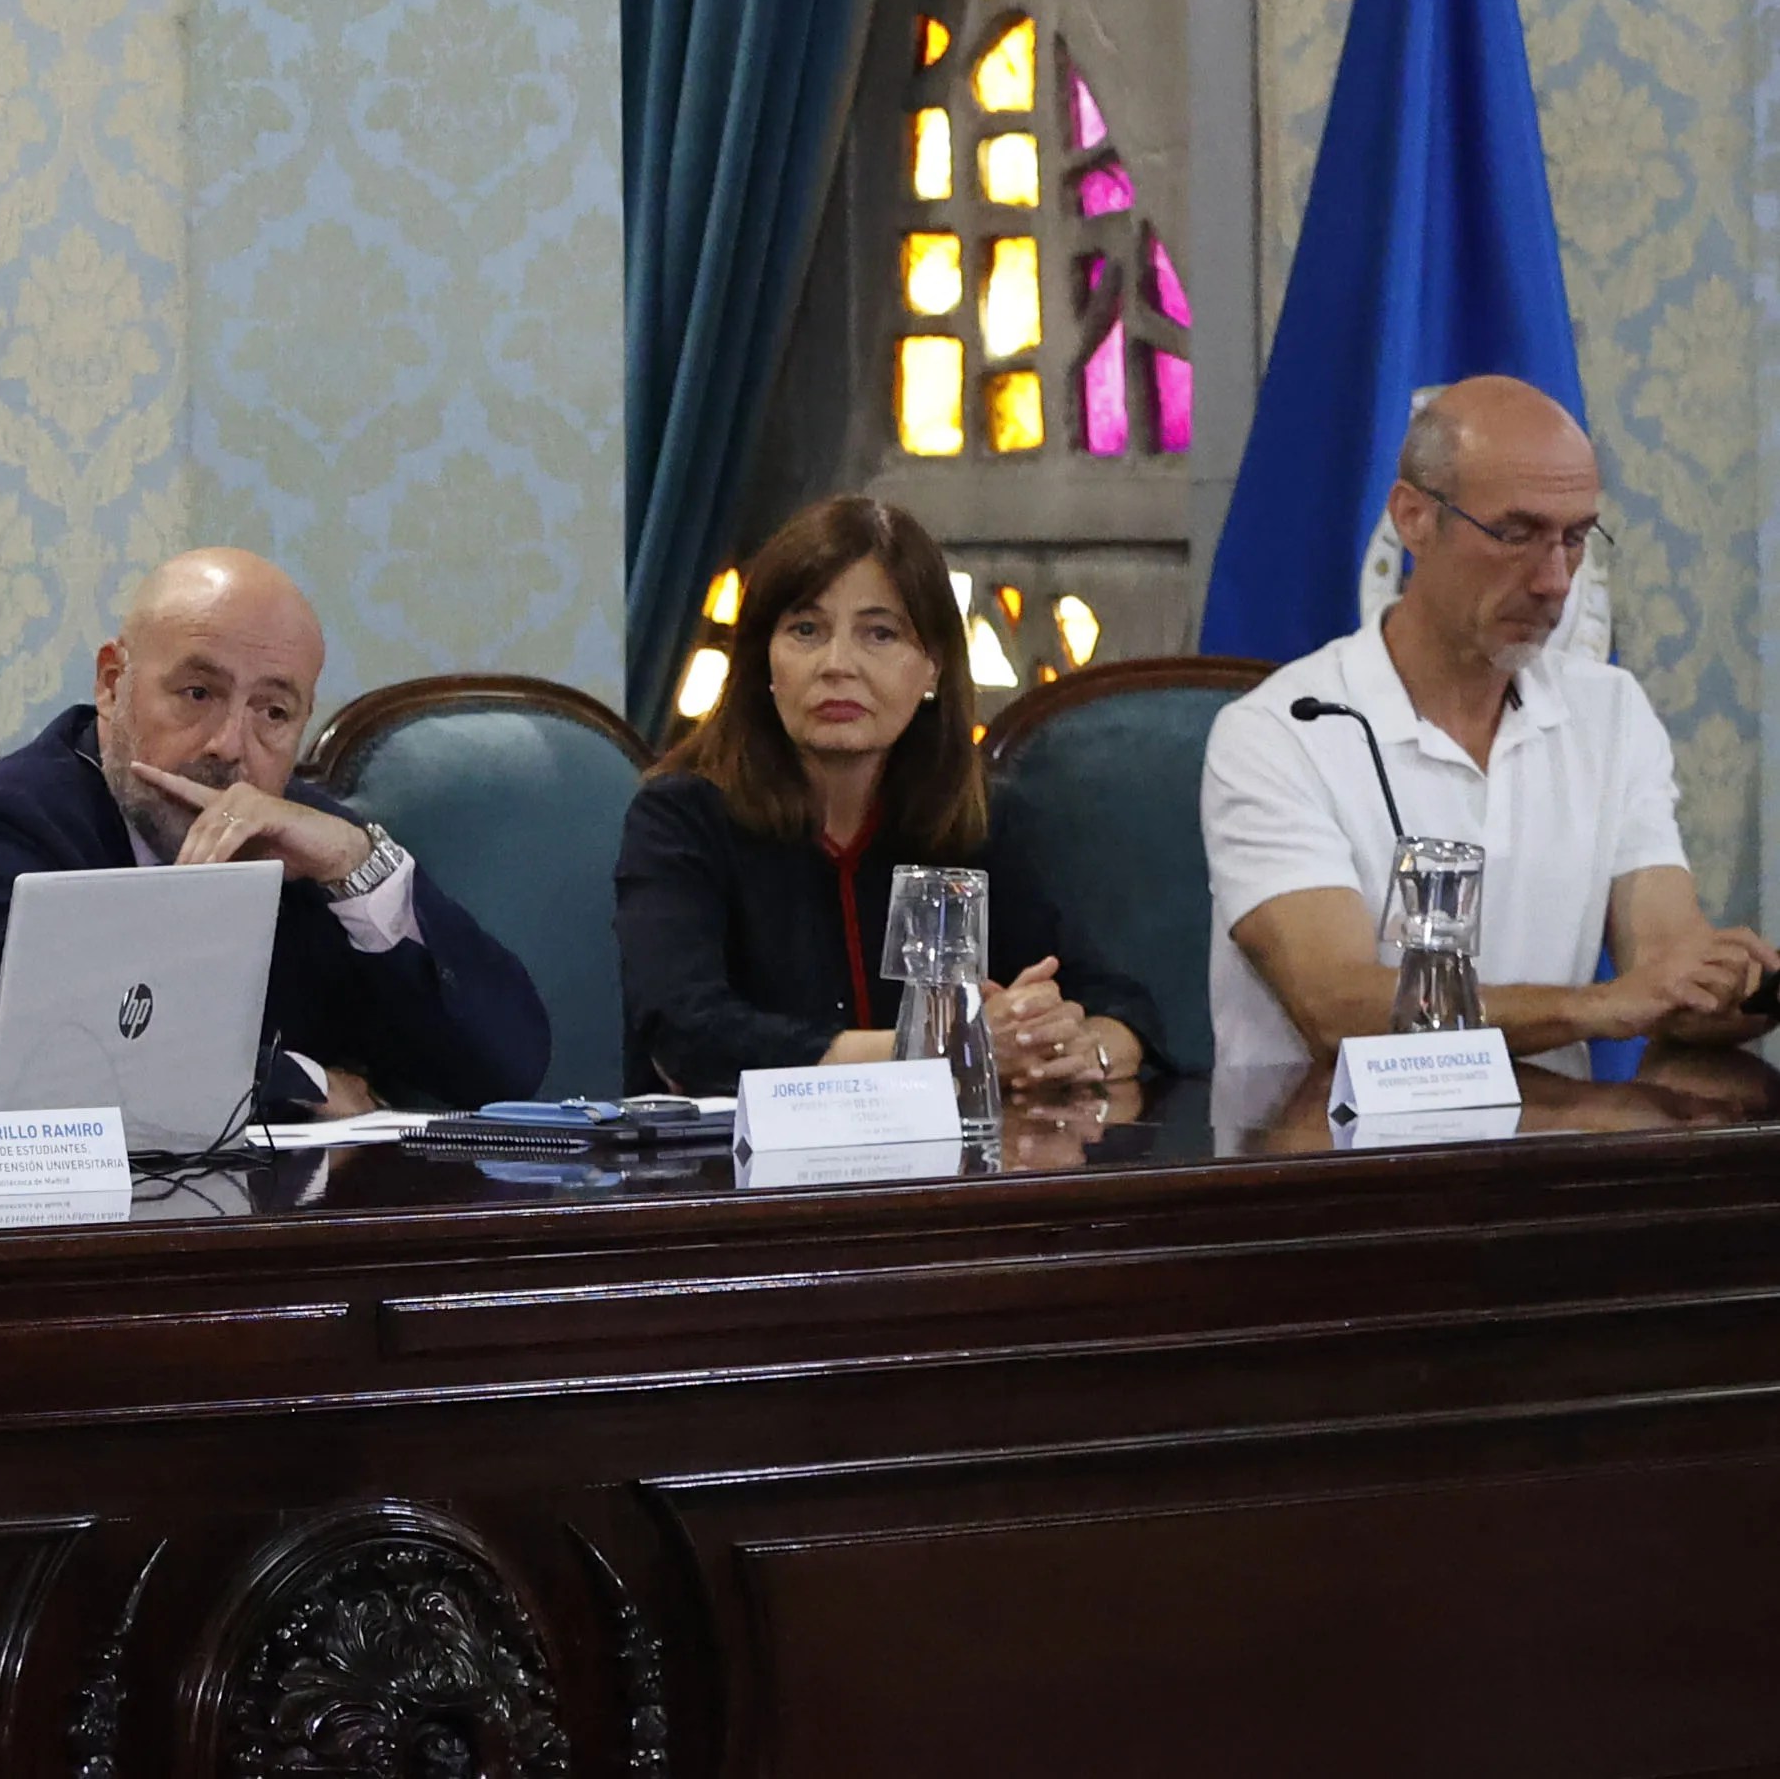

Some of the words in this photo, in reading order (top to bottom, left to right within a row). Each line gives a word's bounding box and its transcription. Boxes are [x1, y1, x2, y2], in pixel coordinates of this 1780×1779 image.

[121, 983, 151, 1039] hp
[771, 1081, 814, 1098] JORGE
[42, 1122, 104, 1138] RAMIRO
[0, 1146, 14, 1157] DE
[46, 1157, 124, 1171] UNIVERSITARIA
